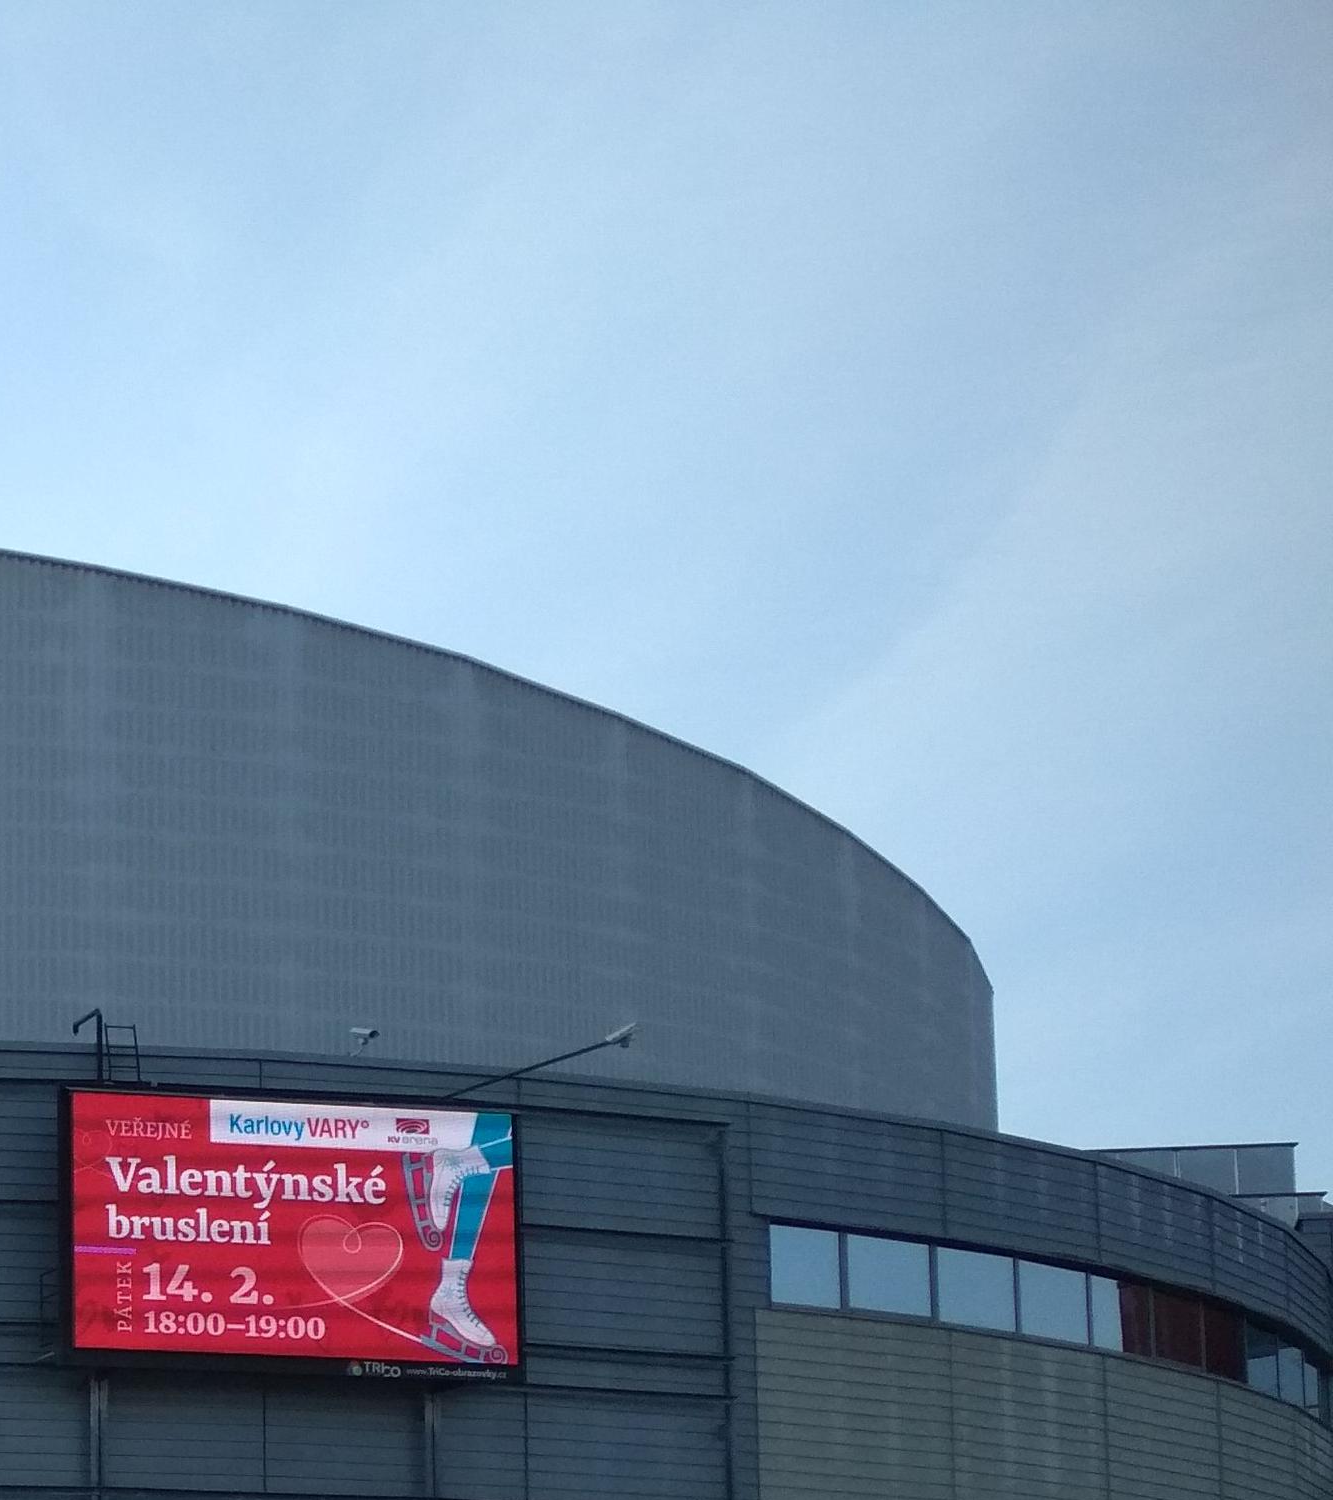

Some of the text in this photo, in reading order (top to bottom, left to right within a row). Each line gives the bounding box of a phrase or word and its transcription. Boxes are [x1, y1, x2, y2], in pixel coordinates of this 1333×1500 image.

[106, 1117, 192, 1140] VEŘEJNÉ
[105, 1154, 386, 1209] Valentýnské
[105, 1203, 271, 1245] bruslení
[114, 1261, 133, 1333] PÁTEK
[142, 1262, 275, 1305] 14. 2.
